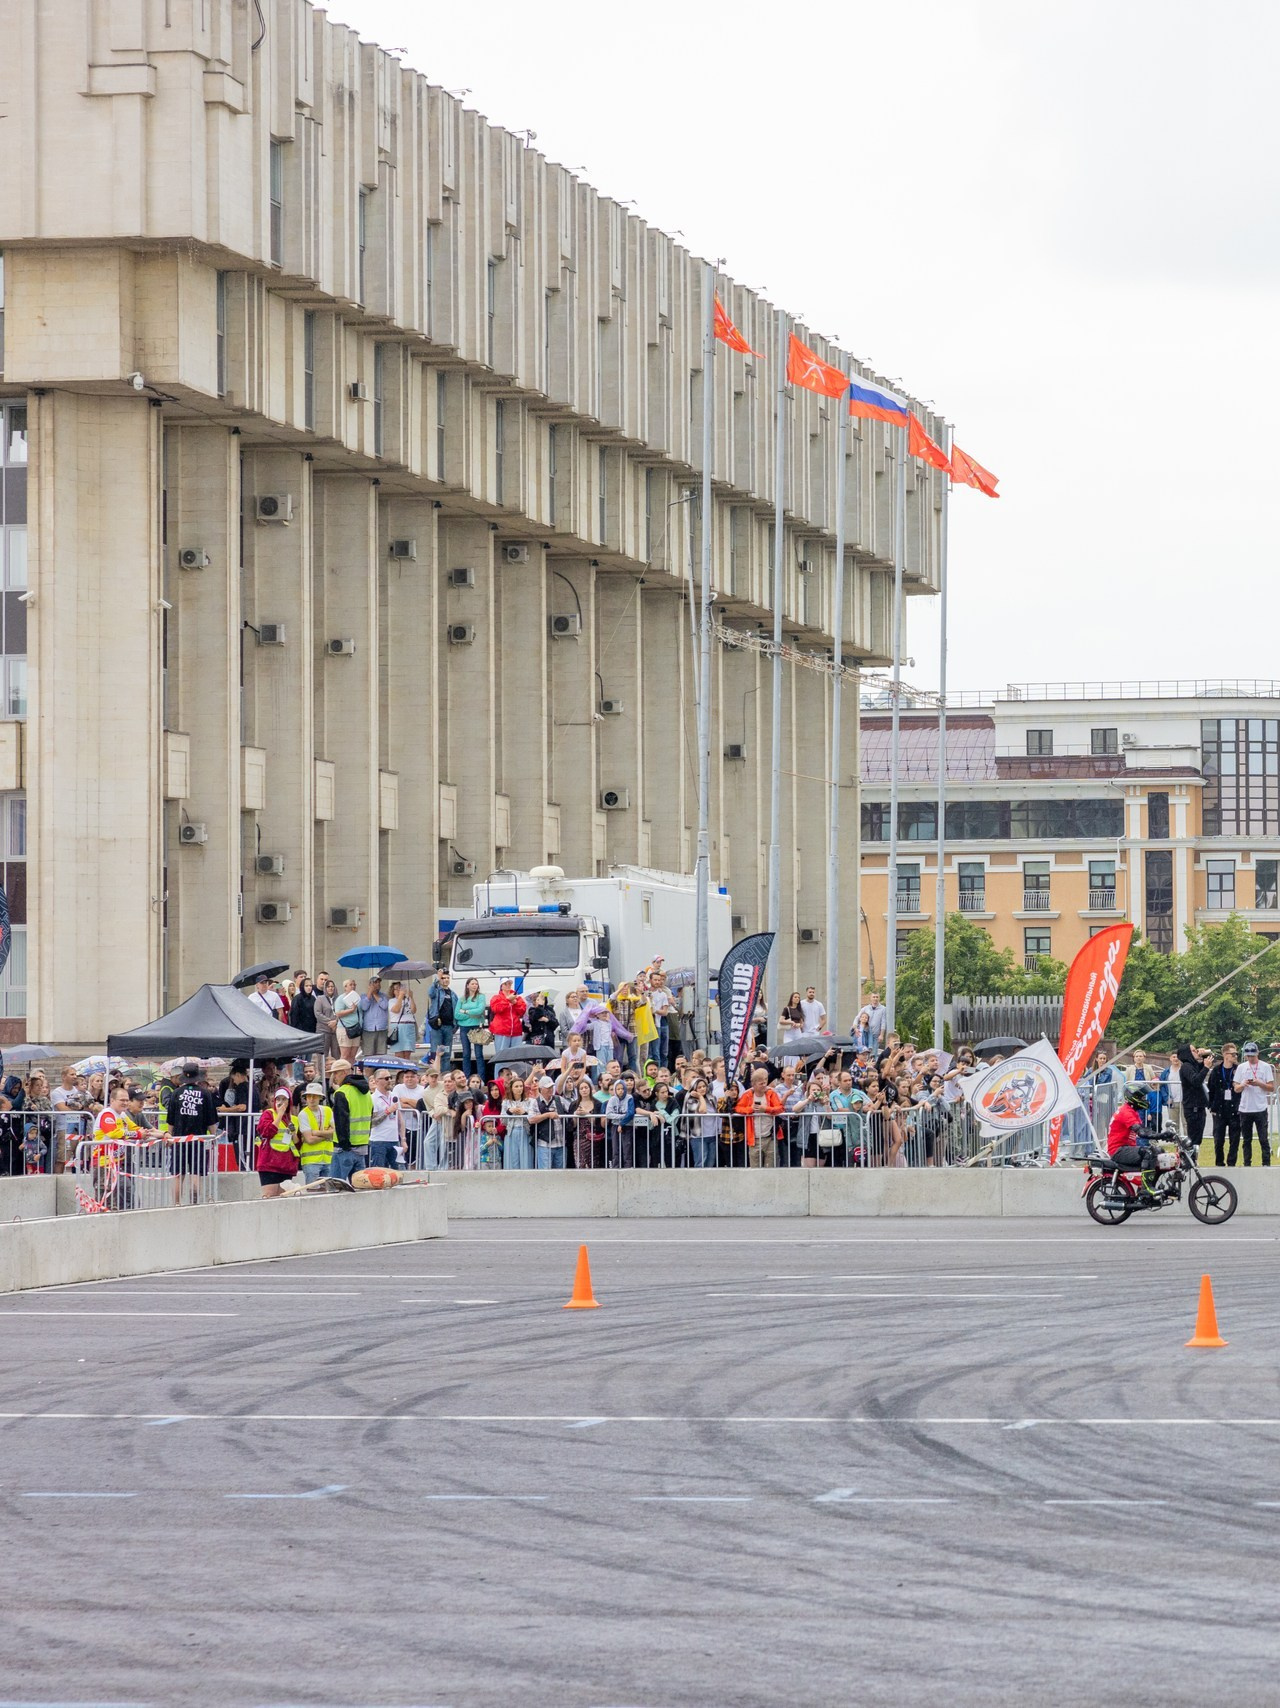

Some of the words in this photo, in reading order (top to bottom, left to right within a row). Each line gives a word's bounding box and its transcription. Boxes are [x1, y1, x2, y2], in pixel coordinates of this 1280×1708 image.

[1077, 972, 1098, 1038] АВТОМОБИЛЬНЫЙ
[183, 1089, 202, 1098] ANTI
[179, 1094, 204, 1105] STOCK
[182, 1100, 197, 1110] CAR
[180, 1107, 199, 1116] CLUB
